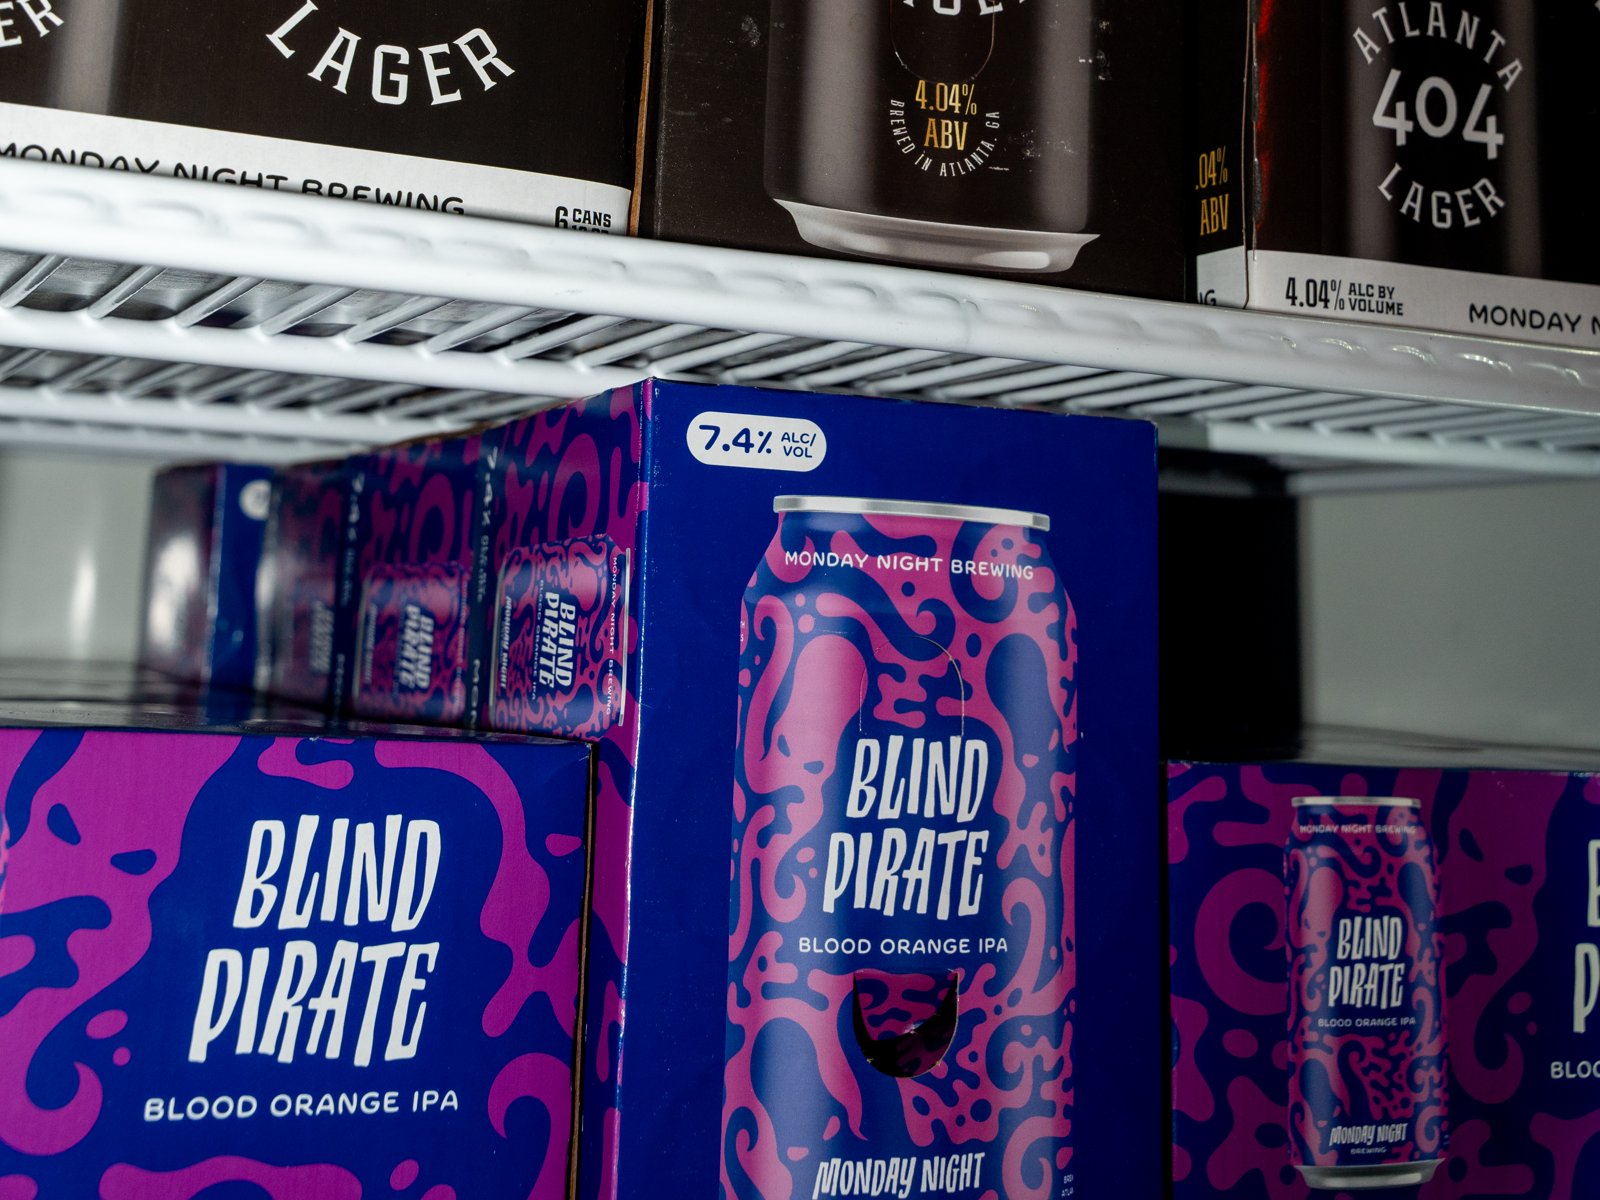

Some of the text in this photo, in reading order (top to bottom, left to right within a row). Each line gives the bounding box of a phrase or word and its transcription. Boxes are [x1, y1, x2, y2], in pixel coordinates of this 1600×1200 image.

[1352, 2, 1523, 91] ATLANTA
[915, 80, 977, 115] 4.04%
[1371, 68, 1504, 160] 404
[889, 99, 916, 154] BREWED
[914, 153, 932, 171] IN
[985, 111, 1000, 129] GA
[924, 118, 968, 151] ABV
[554, 206, 612, 229] 6 CANS
[1200, 194, 1230, 236] ABV
[1377, 163, 1506, 229] LAGER
[1285, 277, 1395, 311] 4.04% ALC BY
[1348, 297, 1404, 316] VOLUME
[1468, 303, 1582, 333] MONDAY
[699, 424, 817, 455] 7.4% ALC/
[783, 445, 813, 459] VOL
[785, 551, 1034, 580] MONDAY NIGHT BREWING
[538, 591, 560, 688] PIRATE
[555, 601, 576, 687] BLIND
[606, 557, 618, 716] MONDAY NIGHT BREWING
[846, 735, 989, 822] BLIND
[232, 814, 442, 933] BLIND
[823, 828, 990, 920] PIRATE
[799, 937, 1008, 954] BLOOD ORANGE IPA
[1336, 915, 1403, 961] BLIND
[188, 939, 441, 1067] PIRATE
[1328, 962, 1405, 1010] PIRATE
[1317, 1016, 1416, 1028] BLOOD ORANGE IPA
[144, 1090, 459, 1122] BLOOD ORANGE IPA
[1328, 1122, 1409, 1147] MONDAY NIGHT
[812, 1152, 986, 1200] MONDAY NIGHT
